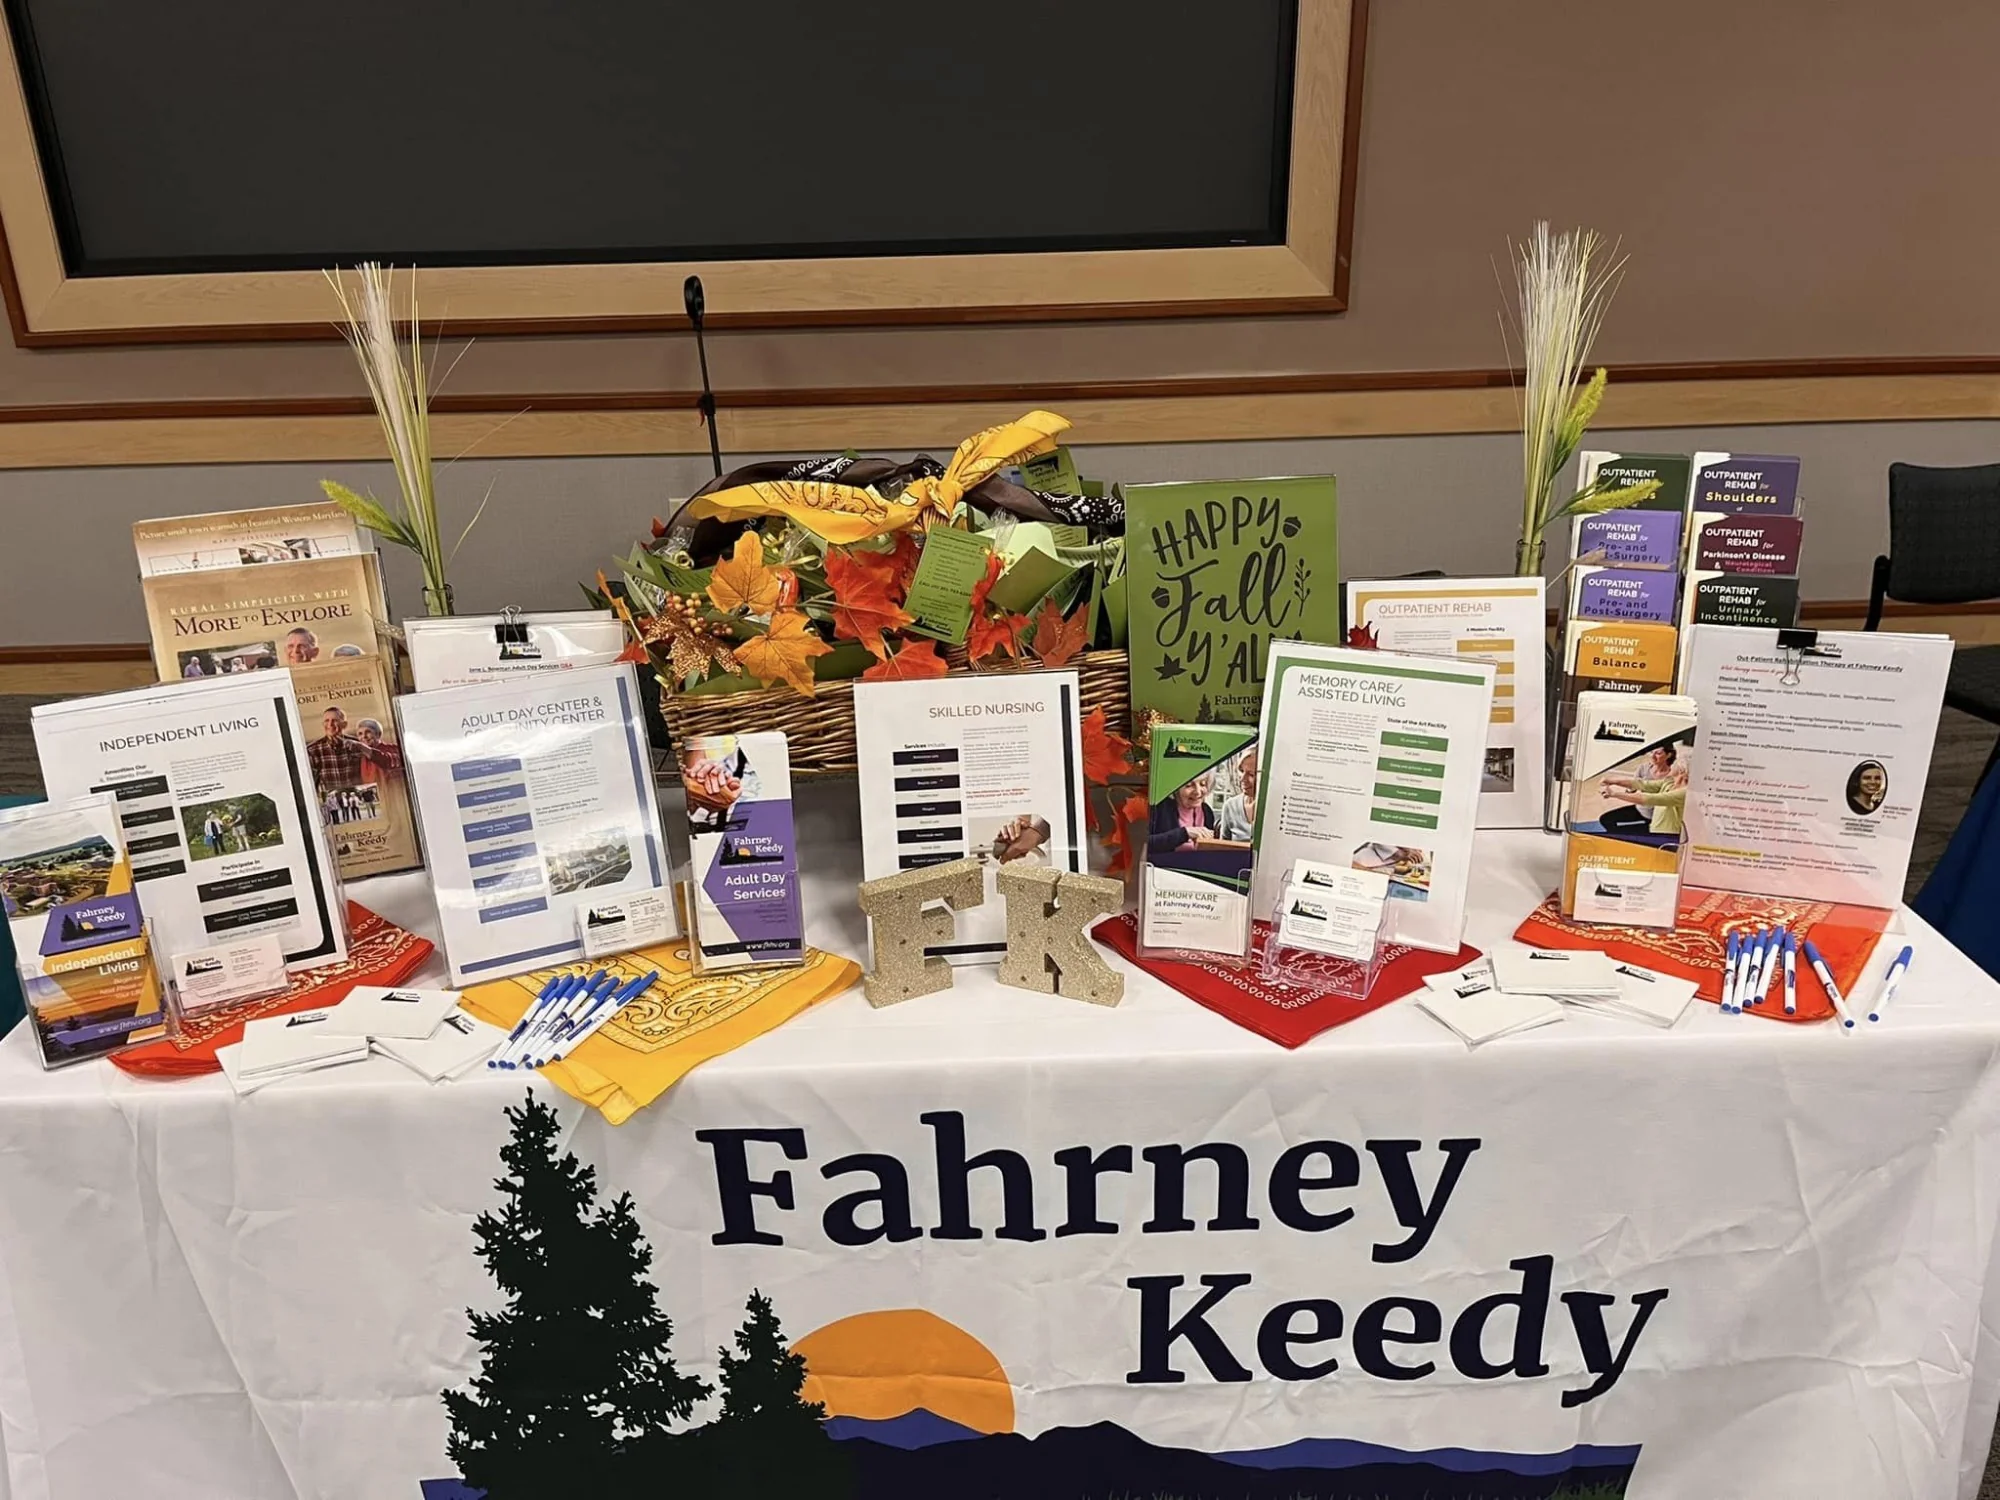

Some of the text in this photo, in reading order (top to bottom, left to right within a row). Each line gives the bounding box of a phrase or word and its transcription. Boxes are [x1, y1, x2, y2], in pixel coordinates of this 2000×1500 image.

[1600, 468, 1657, 478] OUTPATIENT
[1704, 470, 1763, 481] OUTPATIENT
[1725, 480, 1770, 491] REHAB for
[1705, 491, 1778, 504] Shoulders
[168, 527, 188, 537] small
[283, 513, 312, 524] Western
[313, 510, 348, 522] Maryland
[1587, 523, 1642, 532] OUTPATIENT
[1152, 495, 1281, 568] HAPPY
[1606, 532, 1637, 541] REHAB
[1705, 528, 1765, 538] OUTPATIENT
[1625, 544, 1647, 552] and
[1726, 538, 1774, 550] REHAB for
[1703, 551, 1786, 561] Parkinson's Disease
[1714, 561, 1721, 569] &
[1588, 578, 1643, 589] OUTPATIENT
[1156, 543, 1292, 648] Fall
[1607, 589, 1650, 599] REHAB for
[1699, 585, 1760, 596] OUTPATIENT
[170, 589, 349, 616] RURAL SIMPLICITY WITH
[1599, 598, 1649, 609] Pre- and
[1719, 595, 1752, 604] REHAB
[1379, 602, 1492, 615] OUTPATIENT REHAB
[1584, 606, 1662, 620] Post-Surgery
[1719, 605, 1762, 617] Urinary
[174, 603, 353, 637] MORE TO EXPLORE
[1700, 612, 1778, 624] Incontinence
[1584, 635, 1640, 647] OUTPATIENT
[1603, 645, 1634, 655] REHAB
[1187, 629, 1275, 690] Y'AL
[1593, 656, 1647, 670] Balance
[1819, 660, 1847, 669] Therapy
[1855, 663, 1881, 671] Fahrney
[1299, 674, 1403, 694] MEMORY CARE/
[1598, 680, 1642, 692] Fahrney
[297, 686, 374, 706] ORE EXPLORE
[1297, 687, 1406, 708] ASSISTED LIVING
[461, 696, 602, 728] ADULT DAY CENTER &
[929, 701, 1045, 719] SKILLED NURSING
[552, 709, 605, 725] CENTER
[1427, 721, 1447, 730] Facility
[1608, 721, 1638, 729] Fahrney
[100, 717, 259, 752] INDEPENDENT LIVING
[1190, 745, 1211, 753] Keedy
[336, 829, 373, 842] Fahrney
[357, 835, 387, 847] Keedy
[734, 836, 772, 846] Fahrney
[755, 844, 783, 853] Keedy
[1578, 854, 1636, 865] OUTPATIENT
[725, 873, 786, 886] Adult Day
[733, 887, 786, 900] Services
[1195, 893, 1218, 902] CARE
[75, 905, 115, 919] Fahrney
[1163, 901, 1191, 909] Fahrney
[1192, 903, 1215, 912] Keedy
[97, 911, 126, 923] Keedy
[51, 947, 137, 974] Independent
[99, 960, 139, 976] Living
[696, 1110, 1482, 1263] Fahrney
[1127, 1254, 1668, 1409] Keedy
